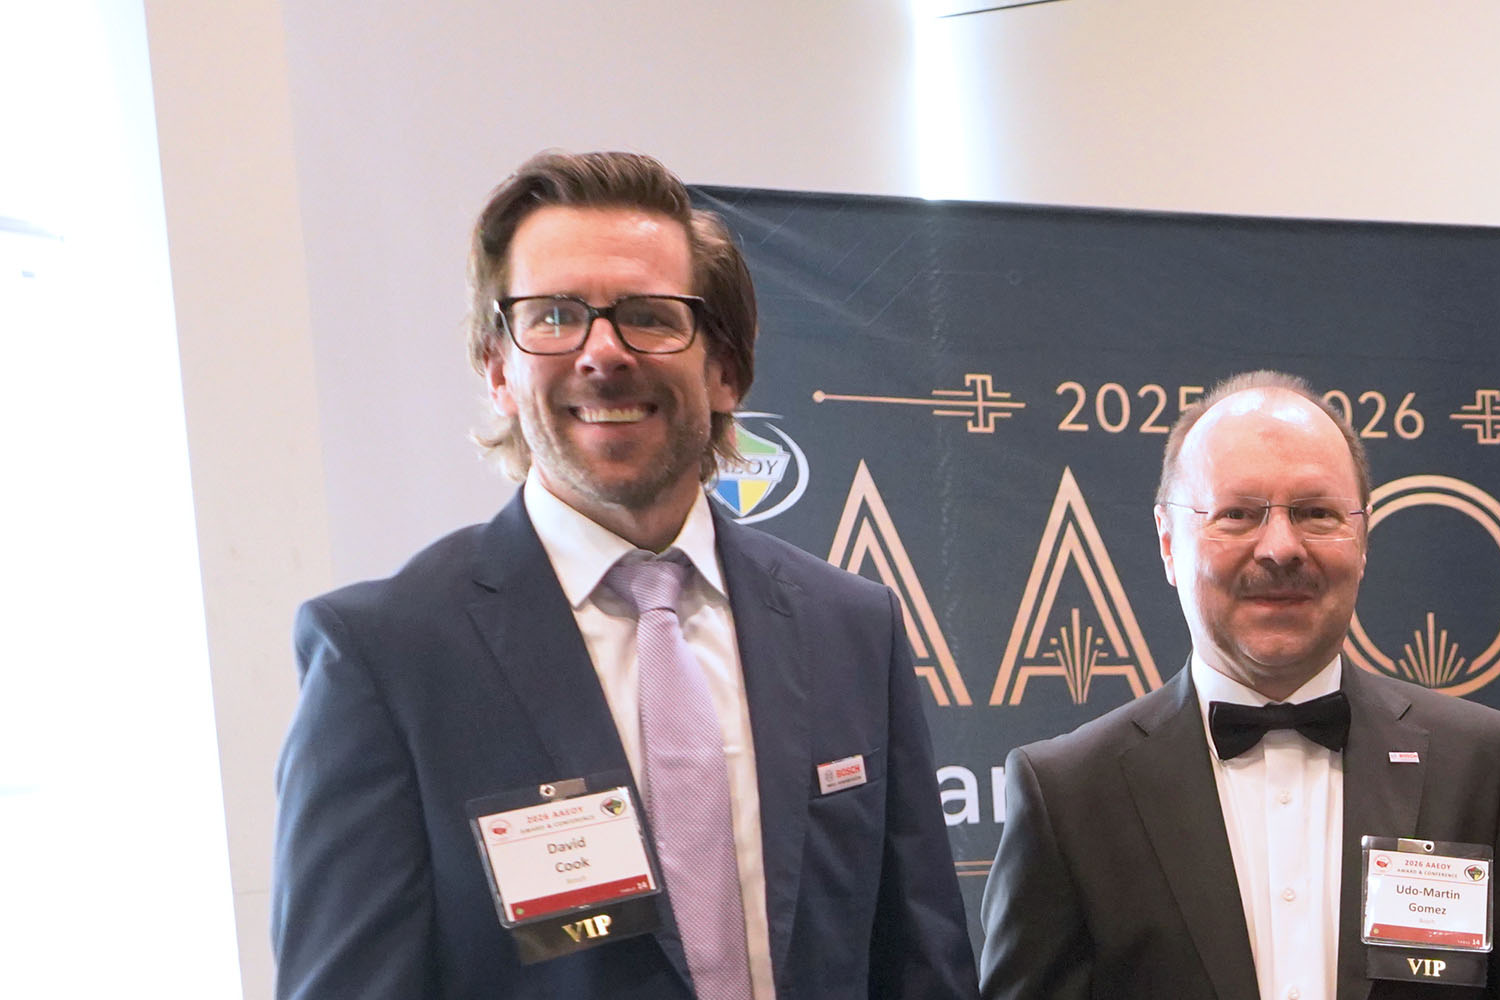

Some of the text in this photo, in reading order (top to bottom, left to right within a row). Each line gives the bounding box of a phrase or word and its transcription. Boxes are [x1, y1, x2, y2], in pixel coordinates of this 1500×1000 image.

[1321, 389, 1425, 440] 026
[546, 837, 587, 855] David
[555, 857, 590, 873] Cook
[1404, 860, 1451, 870] 2026 AAEOY
[1396, 884, 1460, 900] Udo-Martin
[1408, 902, 1447, 915] Gomez
[561, 914, 612, 943] VIP
[1407, 957, 1446, 977] VIP
